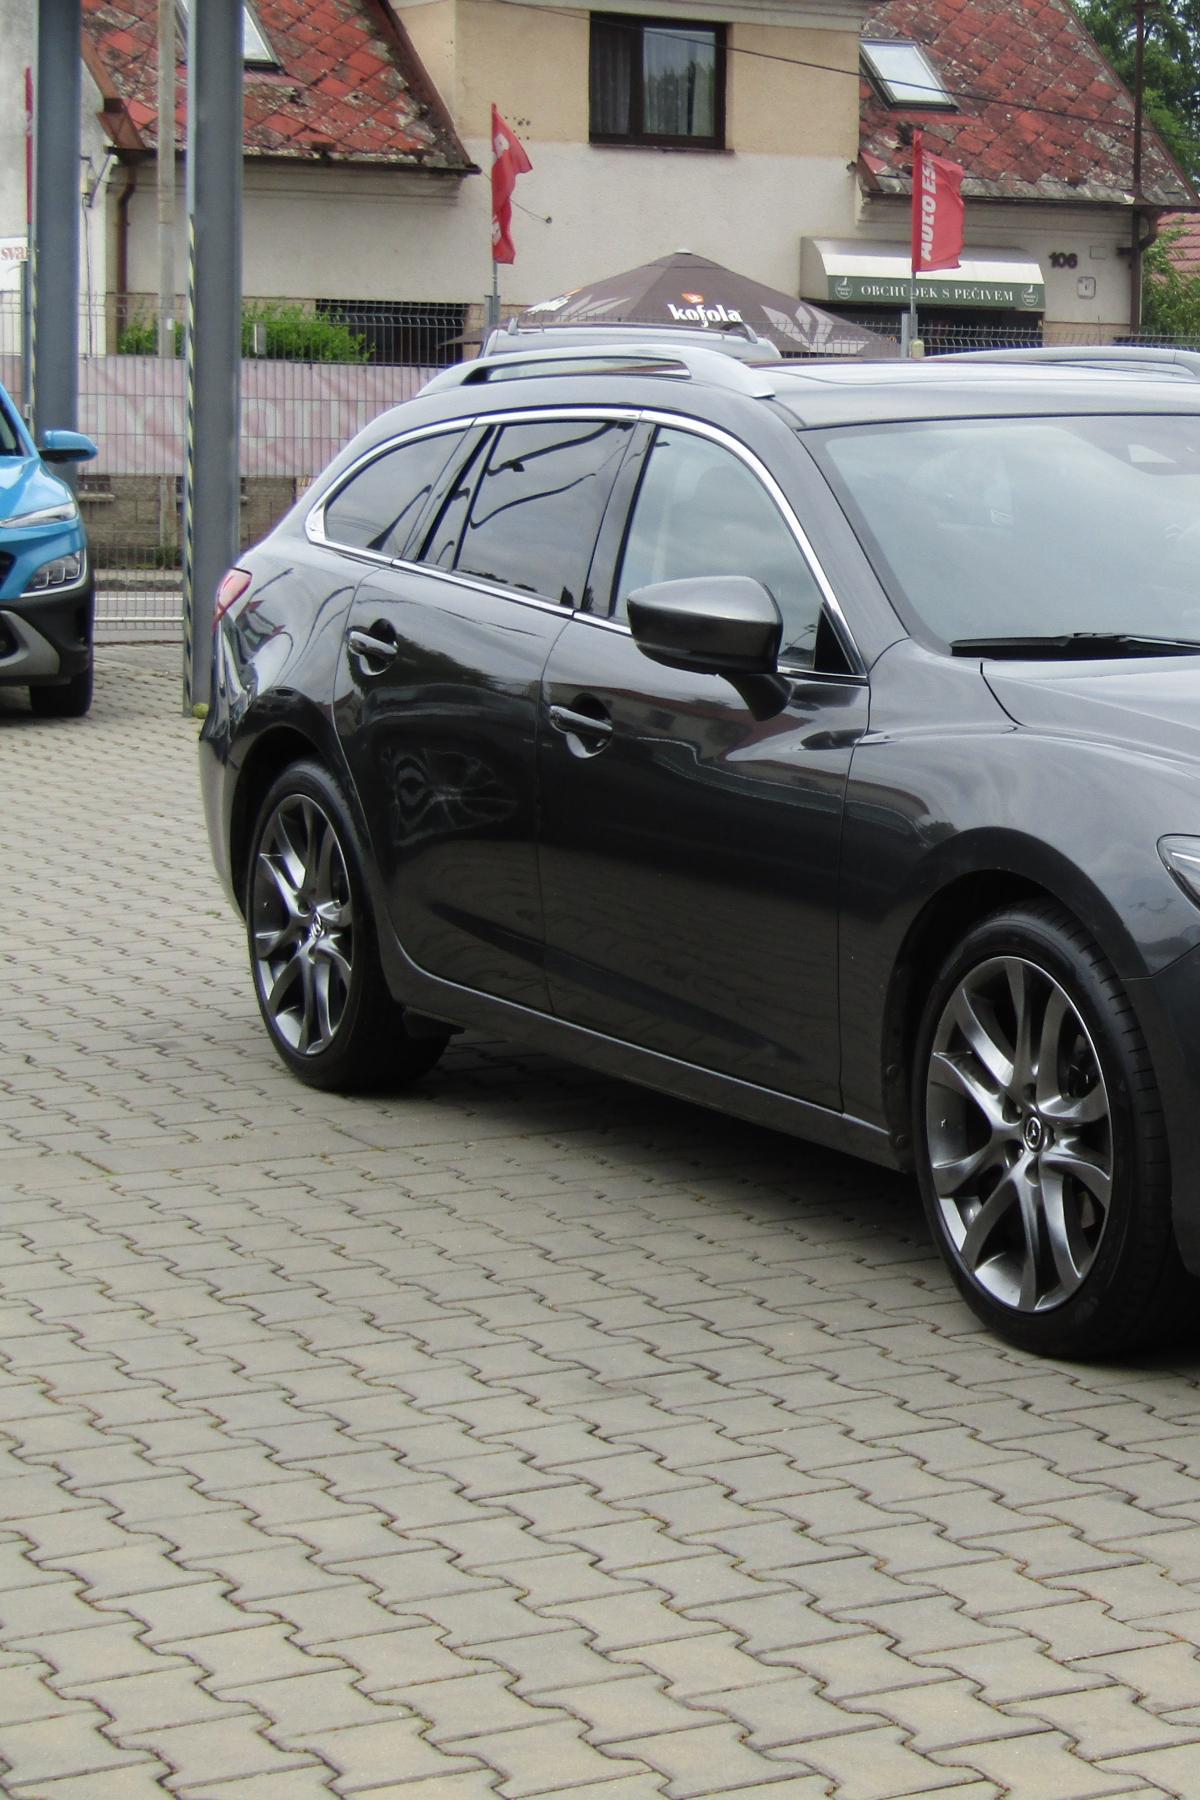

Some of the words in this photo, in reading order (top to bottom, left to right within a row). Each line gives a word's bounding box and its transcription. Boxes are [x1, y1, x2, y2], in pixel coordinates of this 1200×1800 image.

[921, 195, 937, 261] Auto
[1048, 252, 1078, 269] 106
[942, 288, 950, 298] S
[955, 287, 1013, 301] PEČIVEM
[667, 304, 742, 328] kofola
